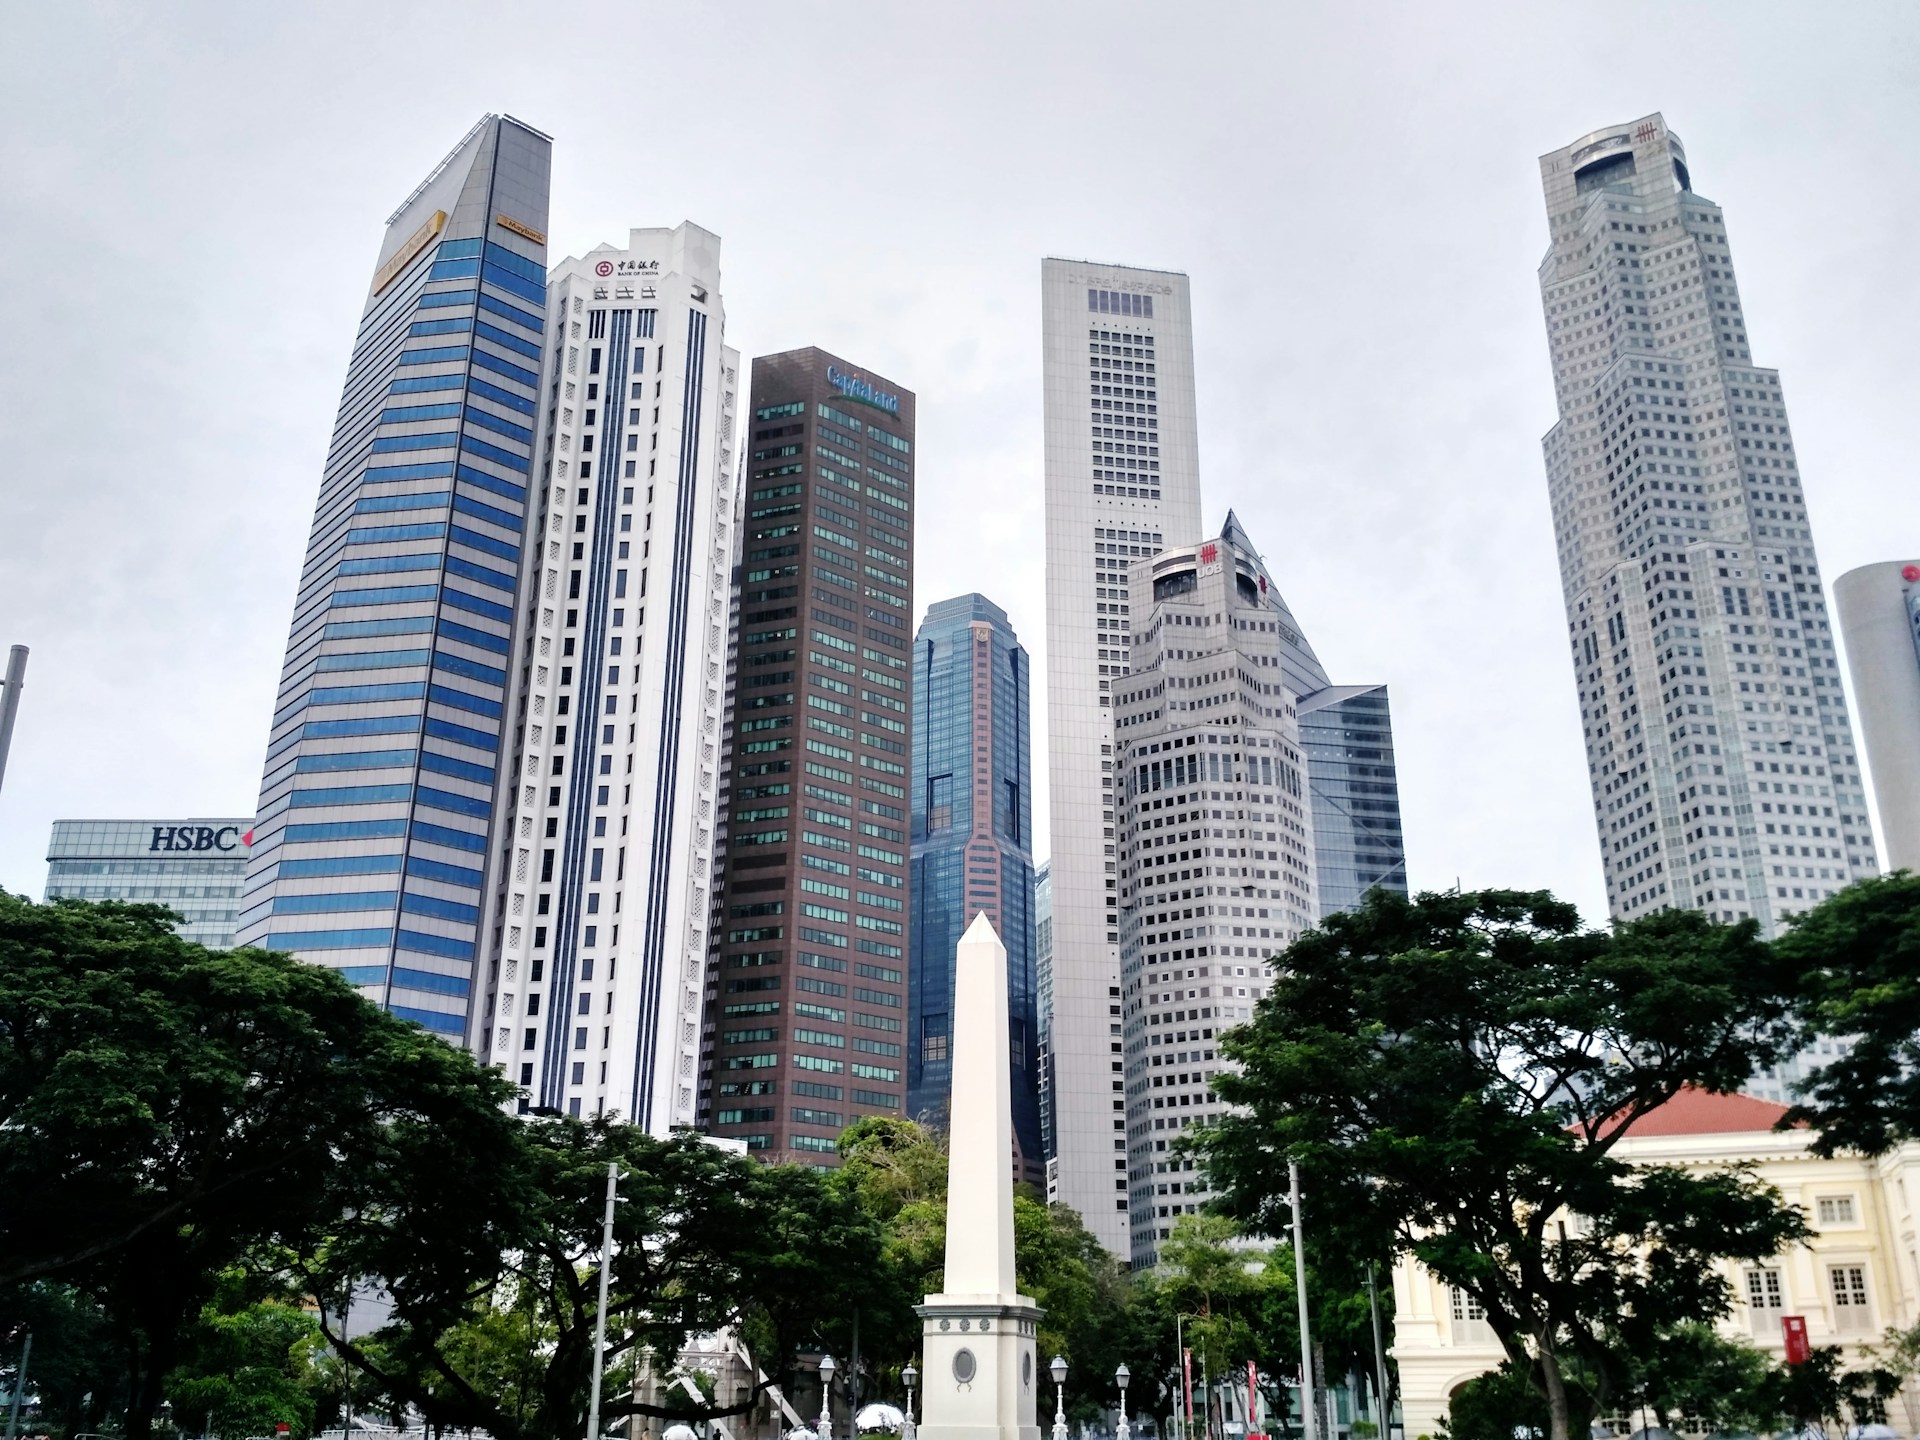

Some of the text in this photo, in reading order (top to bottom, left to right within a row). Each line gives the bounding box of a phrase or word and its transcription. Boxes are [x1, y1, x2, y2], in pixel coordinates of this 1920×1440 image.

[508, 220, 543, 241] Maybank
[827, 365, 897, 411] CapitaLand
[1197, 562, 1223, 579] UOB
[149, 826, 238, 851] HSBC
